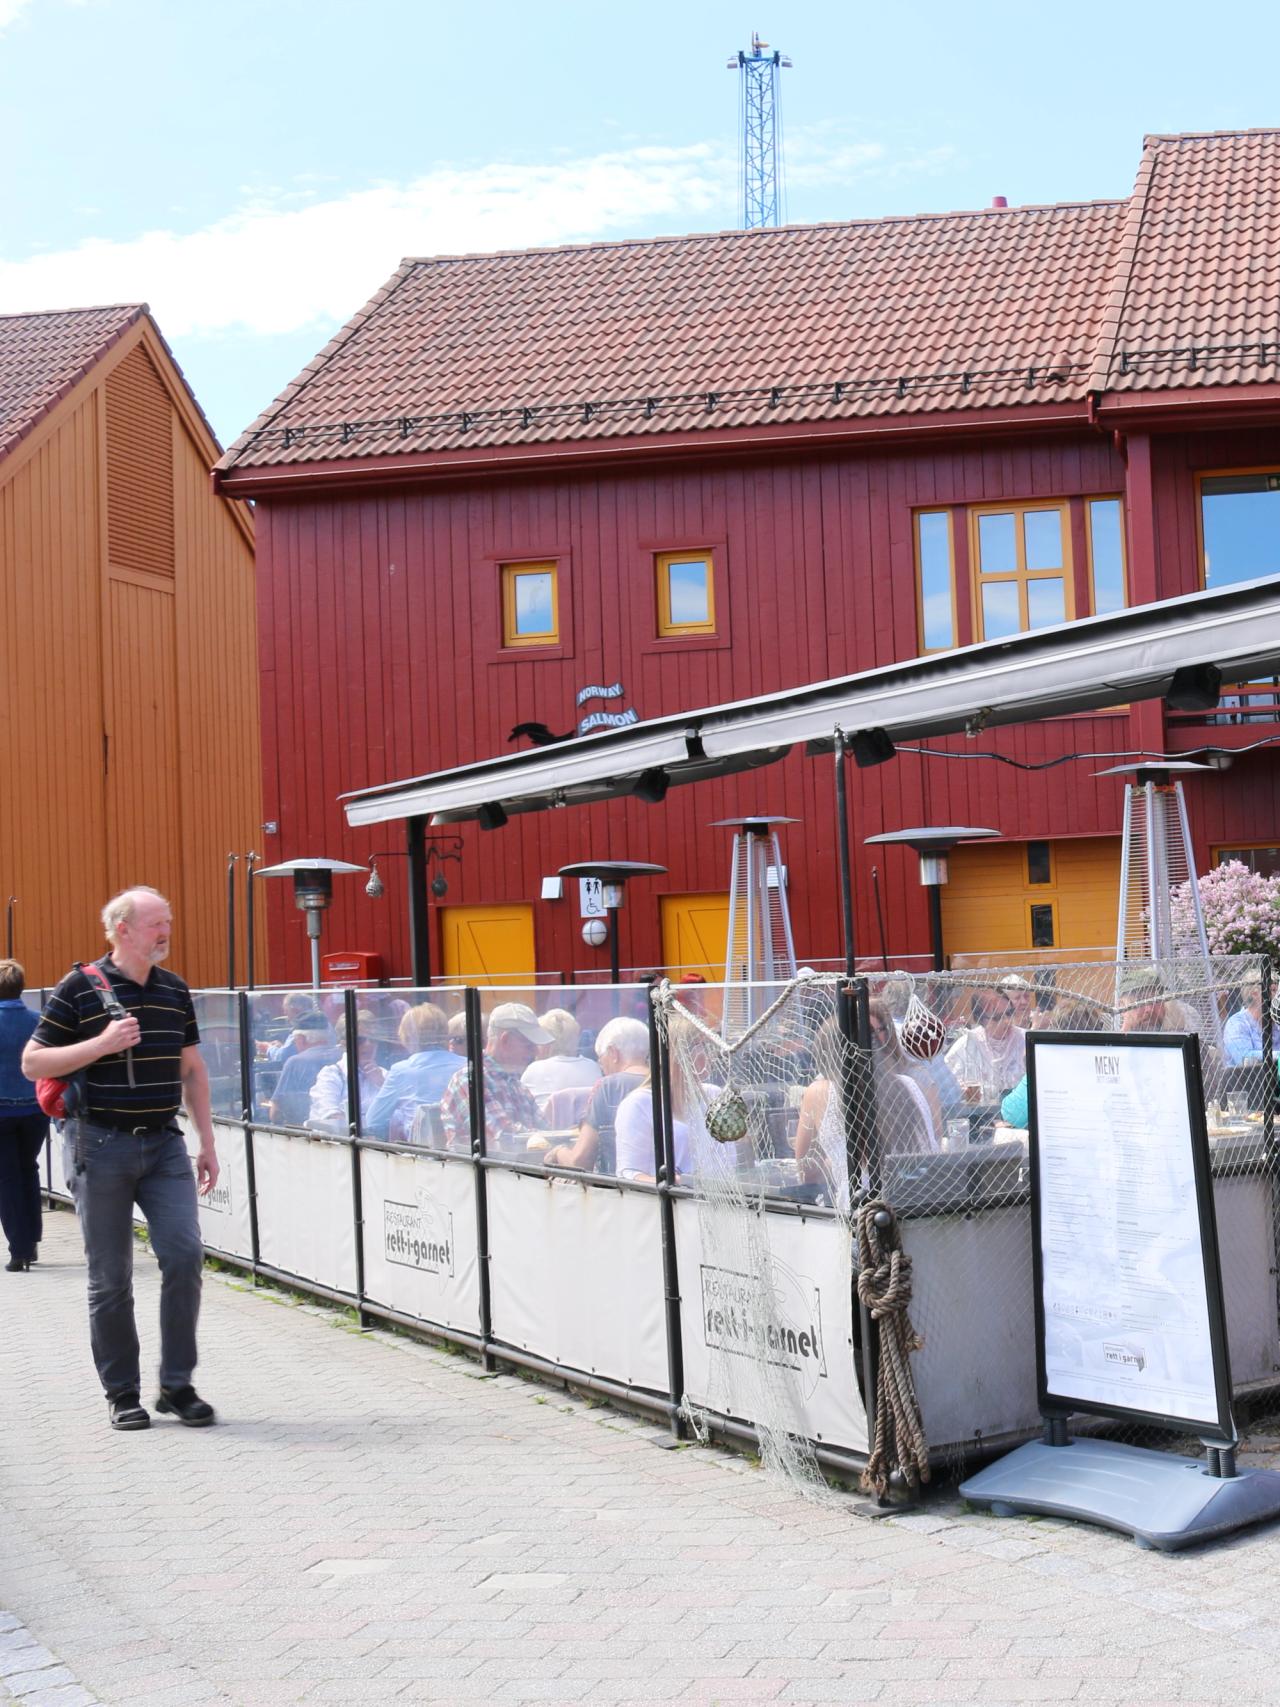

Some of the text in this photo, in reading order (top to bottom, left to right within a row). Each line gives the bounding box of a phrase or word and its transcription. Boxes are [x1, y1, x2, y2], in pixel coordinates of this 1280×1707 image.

[579, 683, 621, 702] NORWAY
[580, 710, 637, 732] SALMON
[1094, 1055, 1120, 1075] MENY
[387, 1230, 450, 1265] rett-i-garnet
